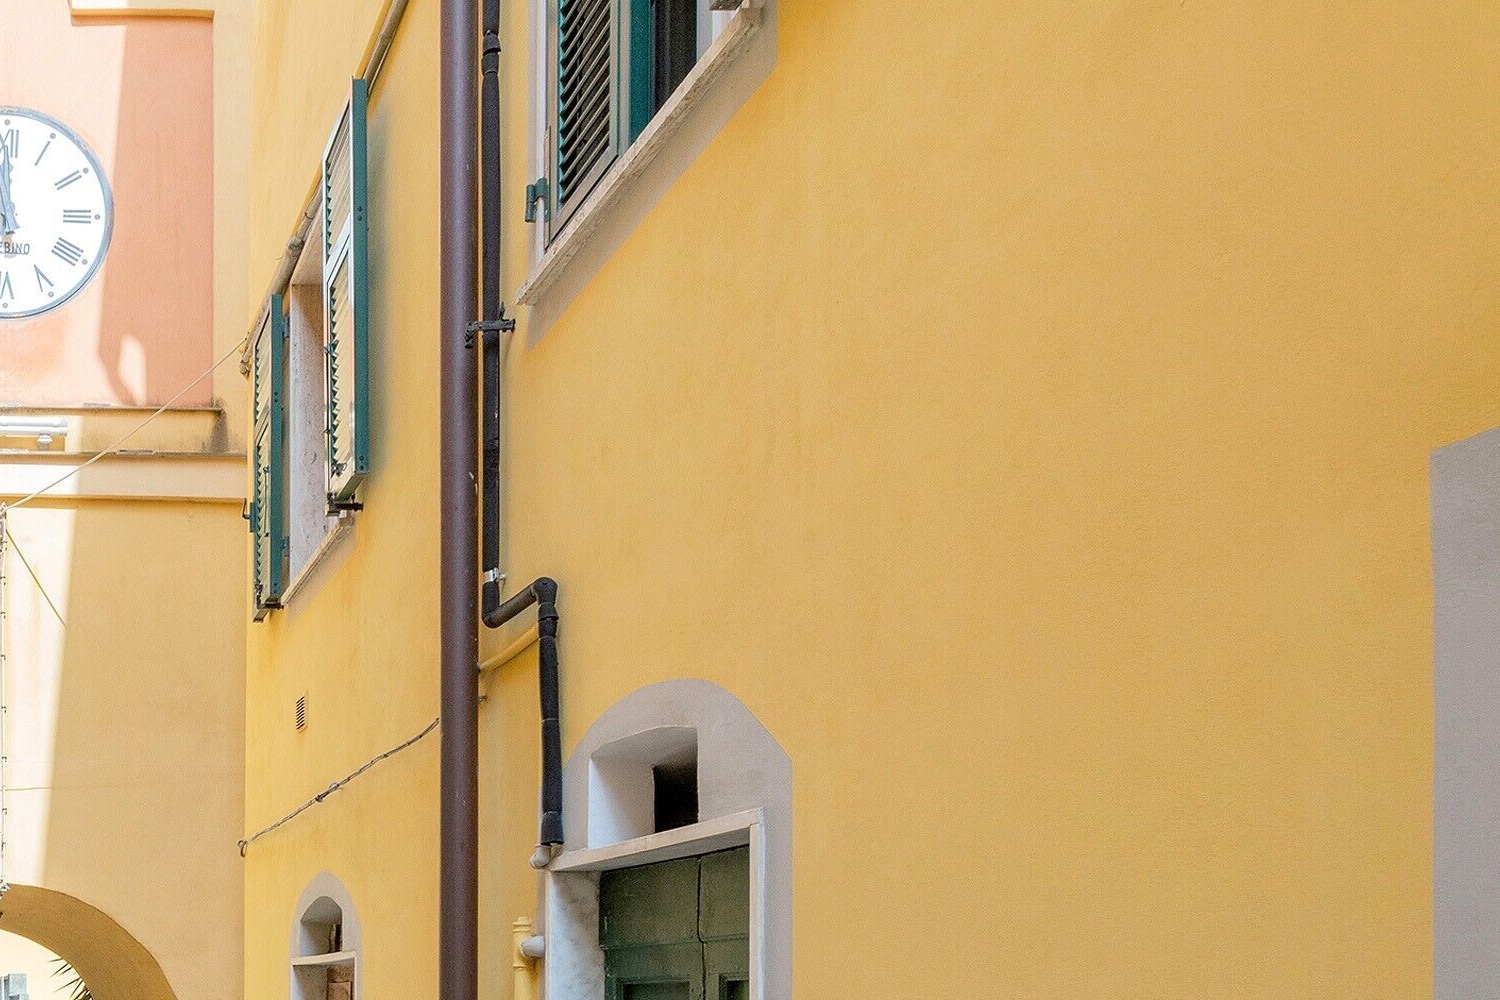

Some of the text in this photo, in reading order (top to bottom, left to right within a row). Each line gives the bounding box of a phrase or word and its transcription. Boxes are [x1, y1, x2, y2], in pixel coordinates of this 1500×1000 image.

[34, 140, 51, 167] I
[54, 169, 83, 190] II
[62, 209, 92, 224] III
[33, 263, 54, 293] V
